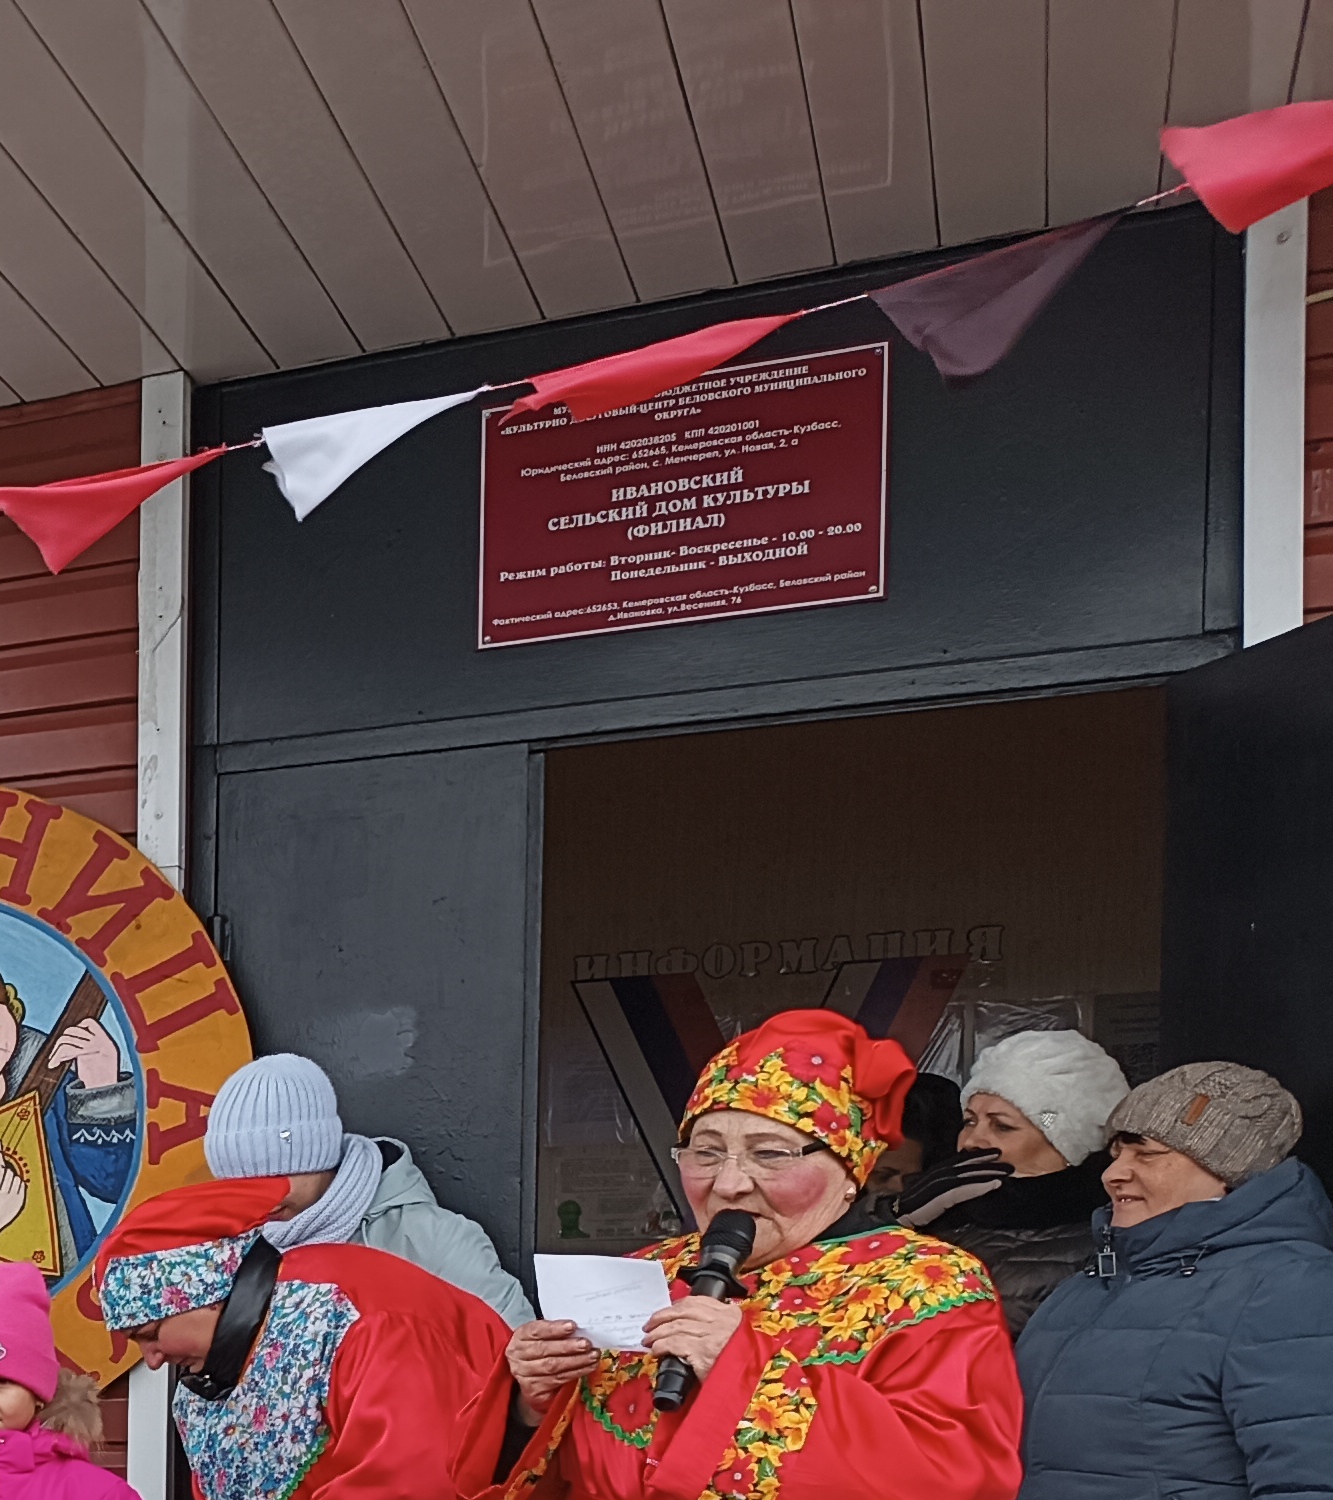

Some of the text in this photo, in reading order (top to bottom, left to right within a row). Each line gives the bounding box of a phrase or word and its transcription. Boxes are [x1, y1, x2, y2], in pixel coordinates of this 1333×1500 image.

[679, 386, 752, 406] БЕЛОВСКОГО
[754, 367, 867, 393] МУНИЦИПАЛЬНОГО
[597, 442, 618, 454] ИНН
[684, 429, 706, 440] КПП
[671, 435, 743, 454] Кемеровская
[611, 466, 744, 503] ИВАНОВСКИЙ
[547, 480, 811, 532] СЕЛЬСКИЙ ДОМ КУЛЬТУРЫ
[627, 513, 726, 541] (ФИЛИАЛ)
[499, 567, 547, 583] Режим
[679, 536, 769, 557] Воскресенье
[782, 529, 815, 542] 10.00
[826, 523, 863, 536] 20.00
[610, 560, 707, 582] Понедельник
[718, 542, 809, 567] ВЫХОДНОЙ
[575, 924, 1005, 981] ИНФОРМАЦИЯ
